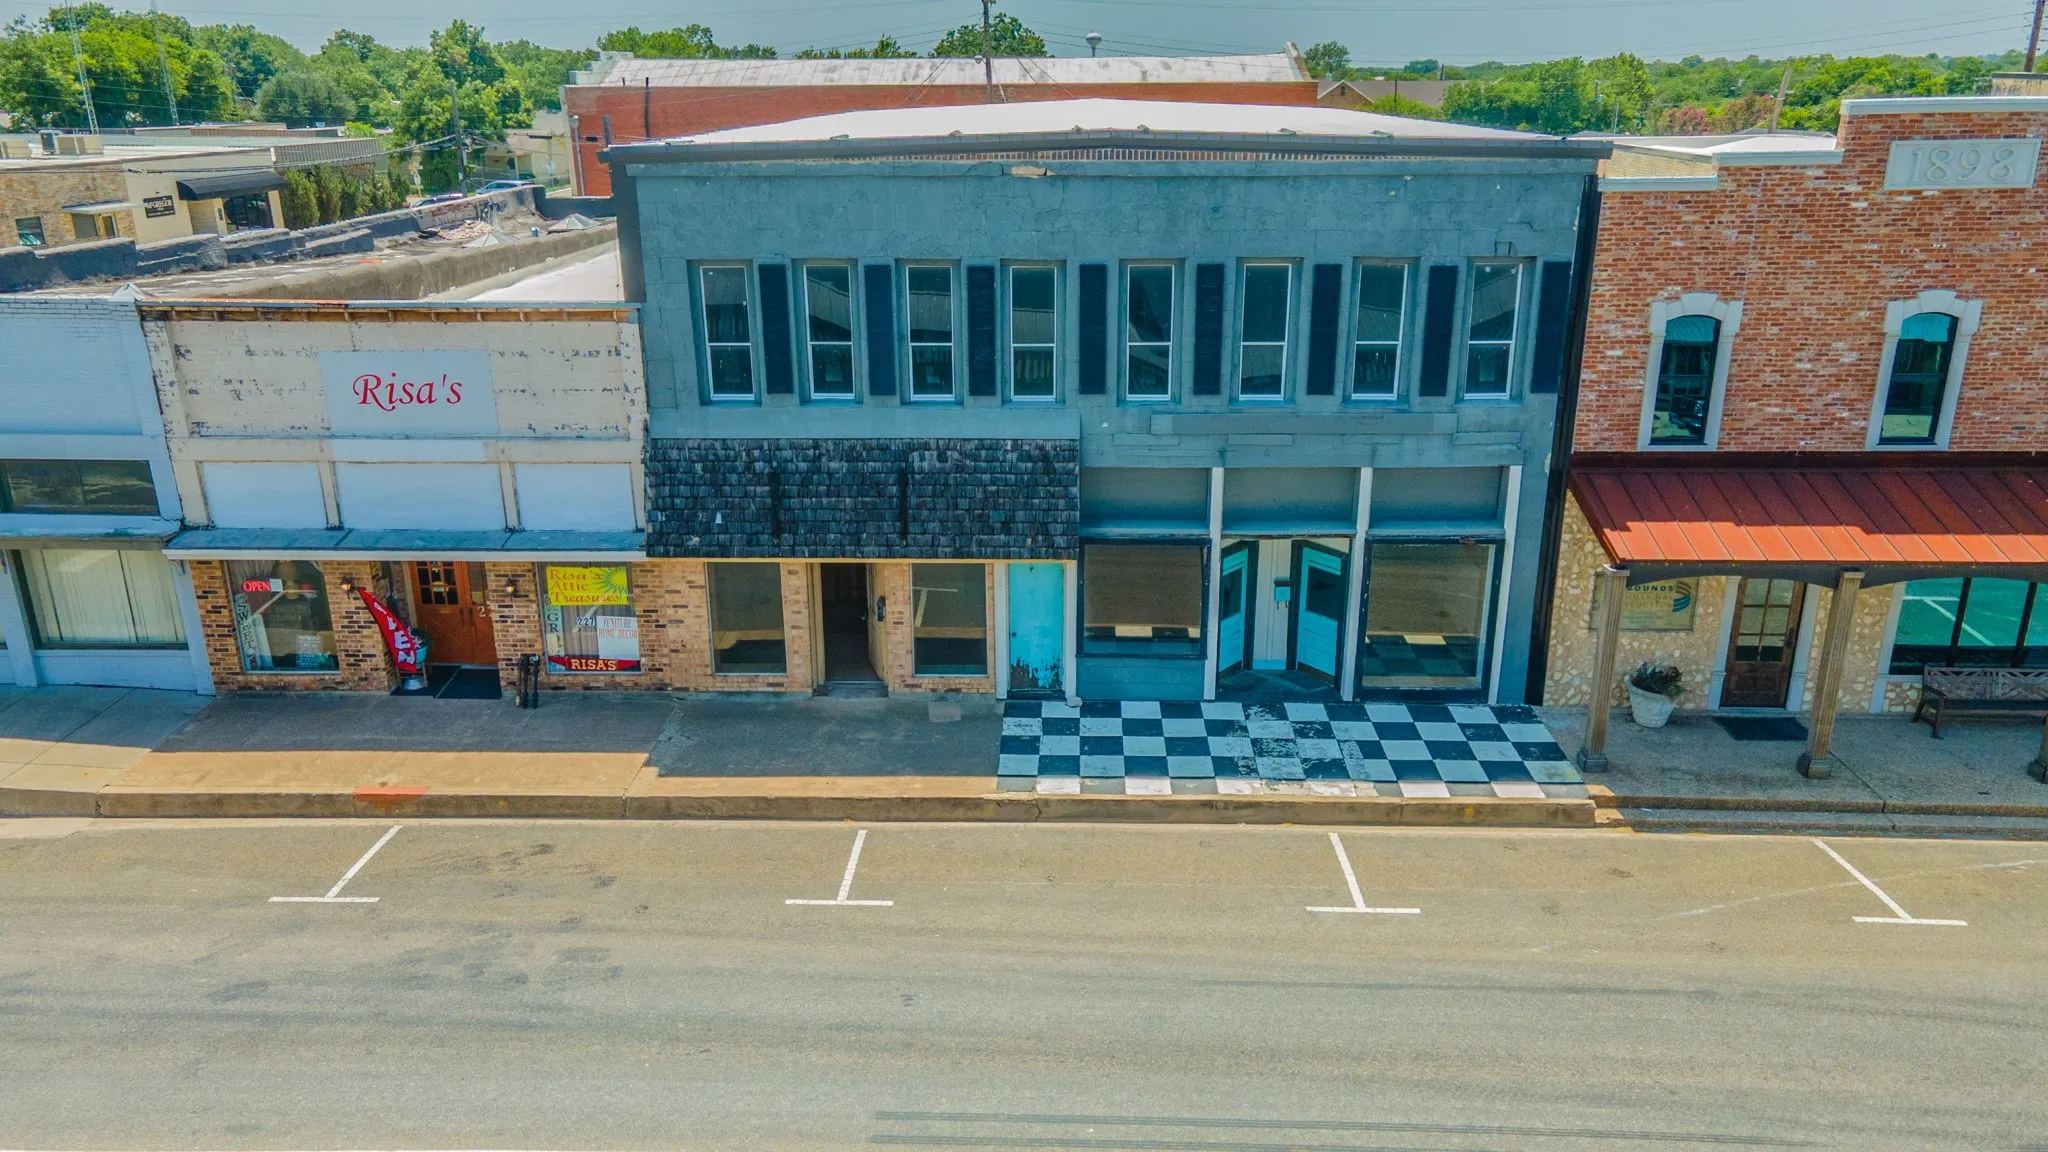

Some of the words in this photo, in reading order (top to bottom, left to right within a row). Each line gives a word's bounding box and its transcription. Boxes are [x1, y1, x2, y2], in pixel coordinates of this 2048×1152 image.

[1909, 148, 2015, 181] 1898
[353, 372, 462, 411] Risa's
[548, 568, 601, 580] Risa's
[243, 581, 270, 592] OPEN
[550, 580, 588, 592] Attic
[550, 591, 619, 603] Treasures
[577, 616, 595, 626] 227
[599, 628, 615, 638] HOME
[570, 659, 617, 671] RISA'S
